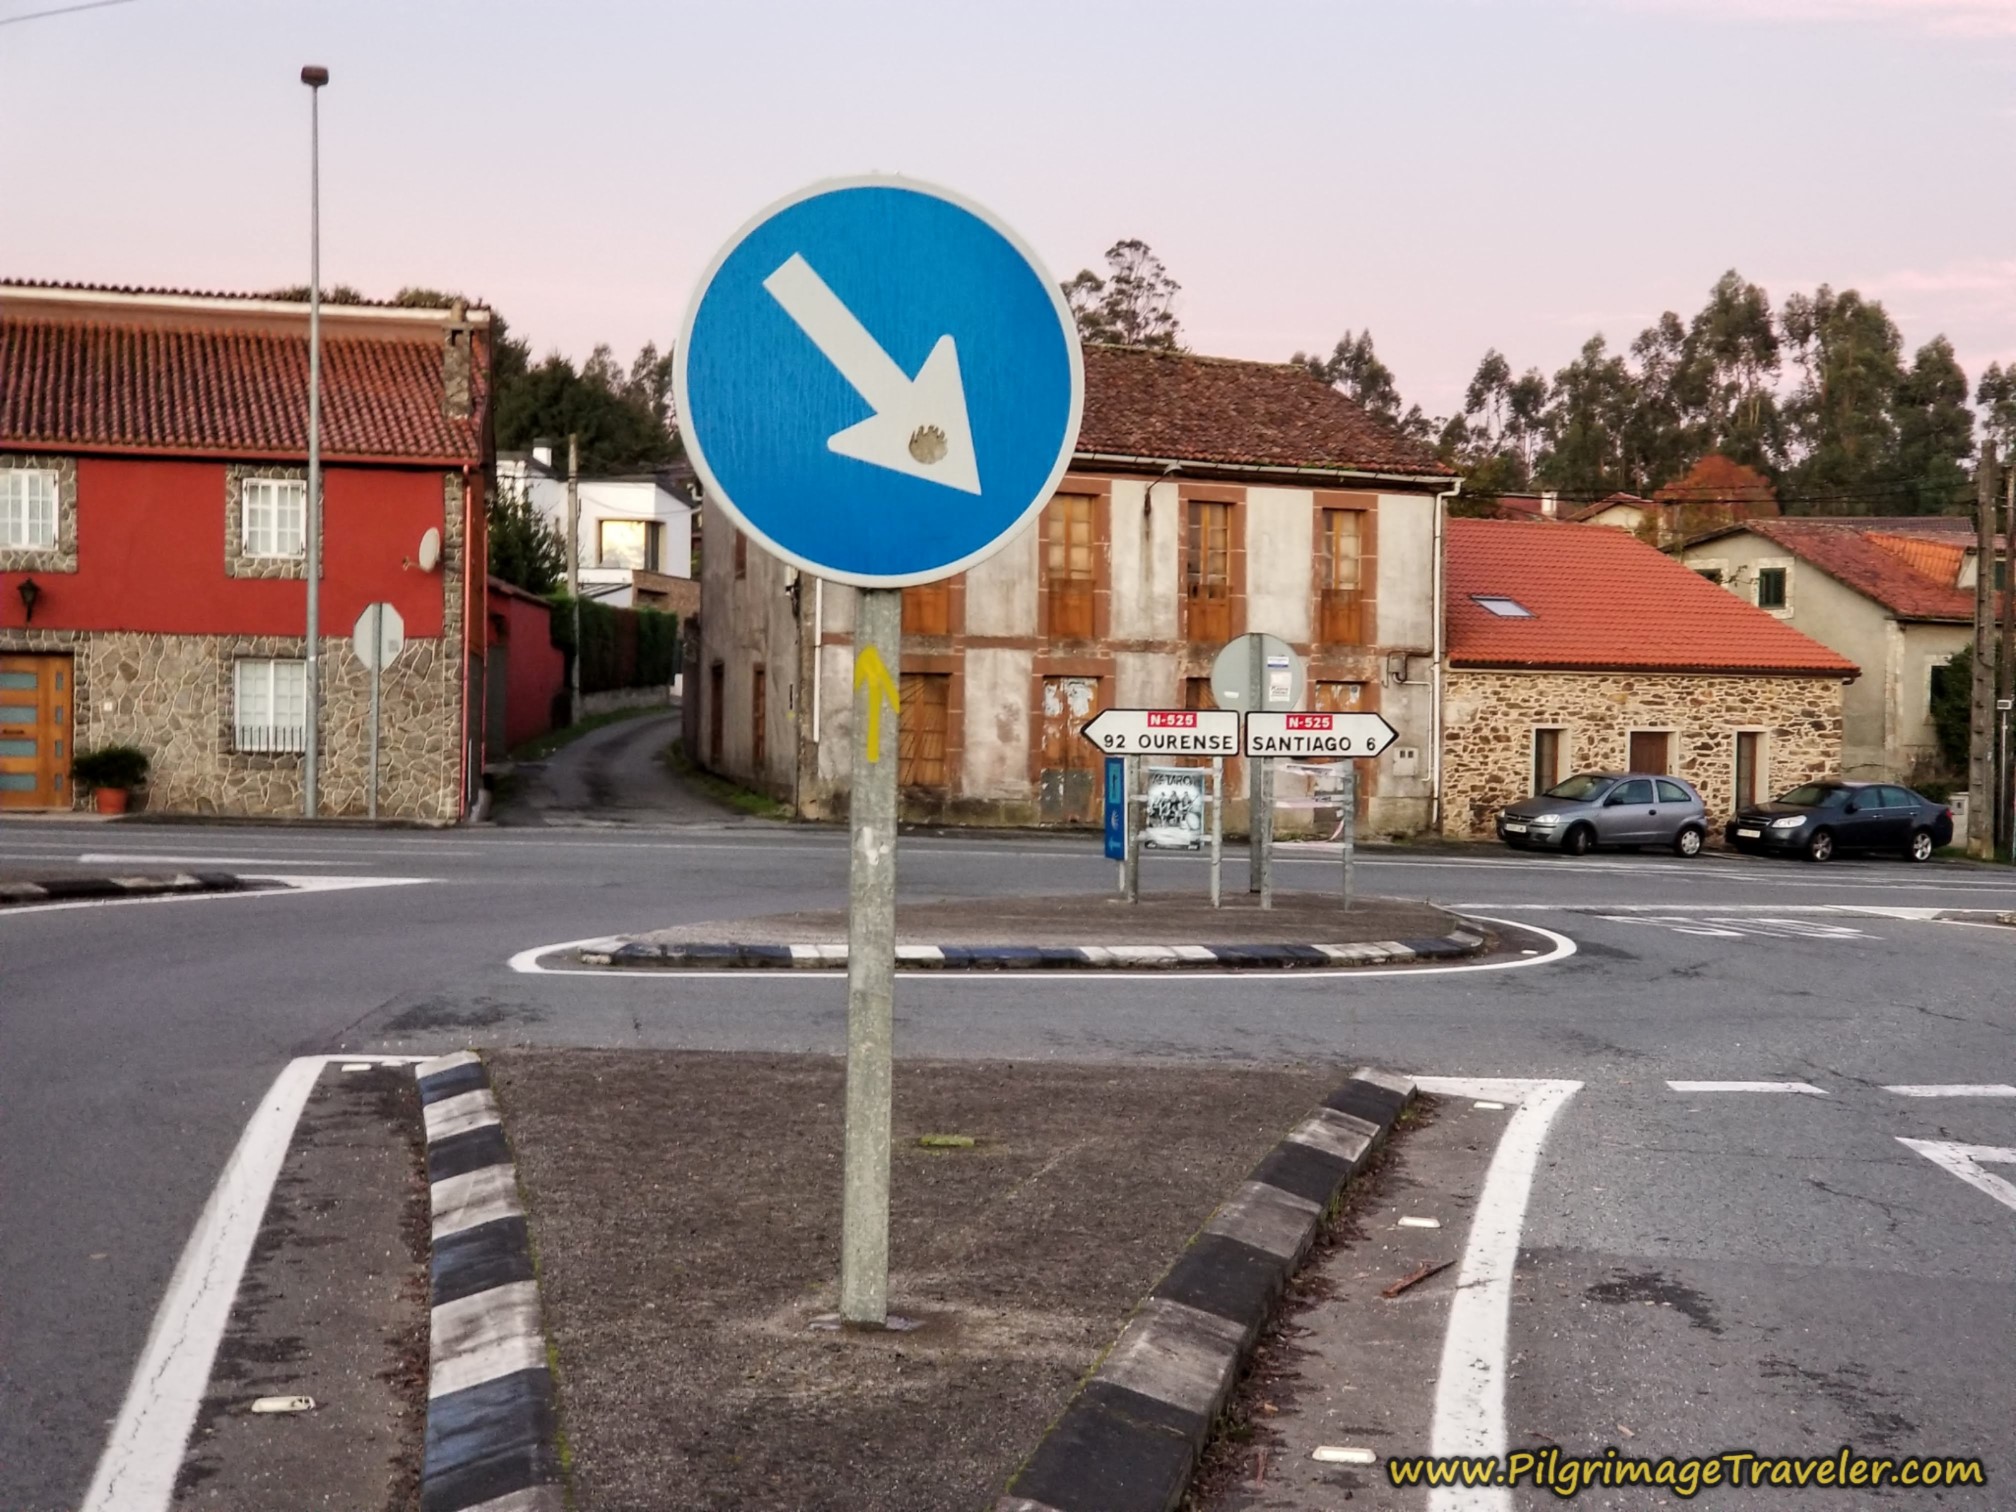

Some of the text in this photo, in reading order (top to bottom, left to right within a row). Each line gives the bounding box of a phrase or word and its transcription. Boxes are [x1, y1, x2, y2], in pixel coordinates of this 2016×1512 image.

[1149, 713, 1194, 726] N-525
[1288, 716, 1331, 728] N-525
[1103, 734, 1234, 750] 92 OURENSE
[1252, 736, 1377, 752] SANTIAGO 6
